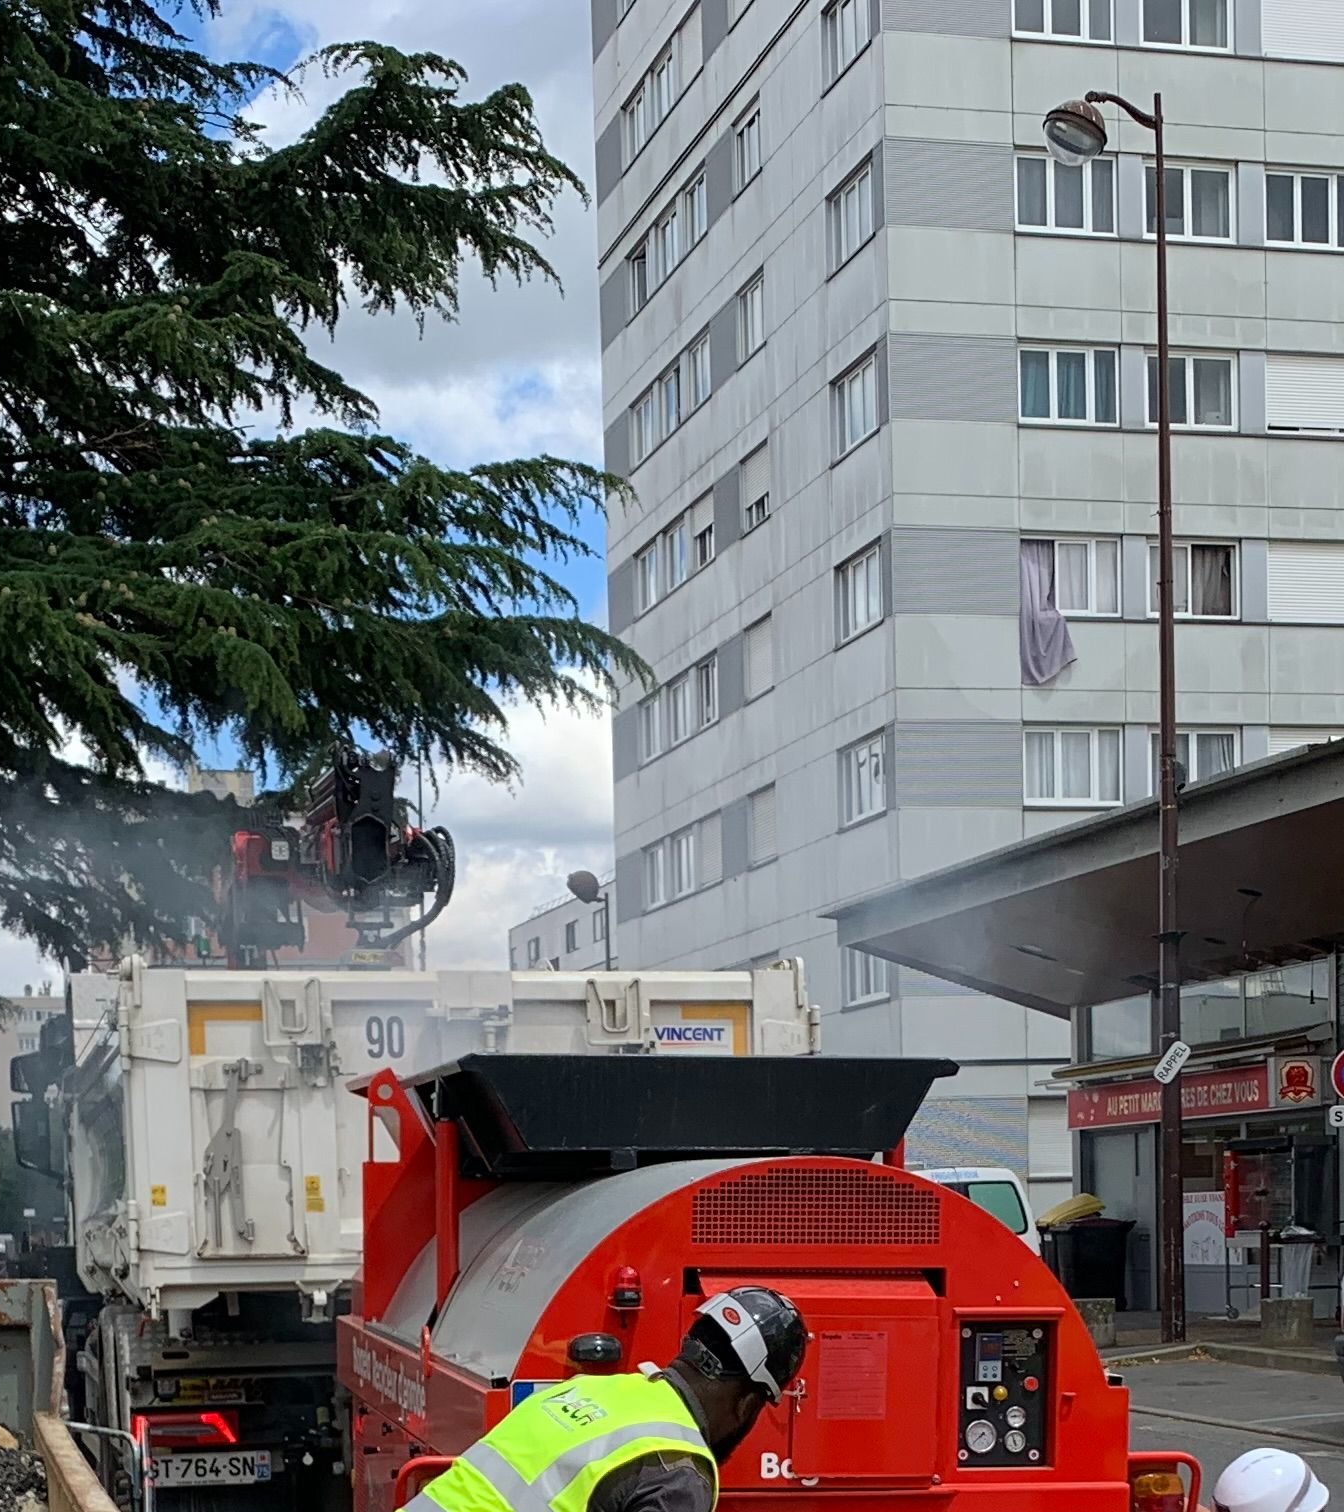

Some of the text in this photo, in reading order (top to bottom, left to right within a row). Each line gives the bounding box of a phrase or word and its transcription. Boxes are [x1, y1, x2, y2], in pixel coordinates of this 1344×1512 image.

[366, 1016, 405, 1059] 90
[654, 1027, 725, 1041] VINCENT
[1158, 1045, 1188, 1082] RAPPEL
[1107, 1098, 1118, 1117] AU
[1119, 1094, 1140, 1114] PETIT
[1197, 1085, 1208, 1107] DE
[1210, 1082, 1232, 1106] CHEZ
[1234, 1079, 1259, 1102] VOUS
